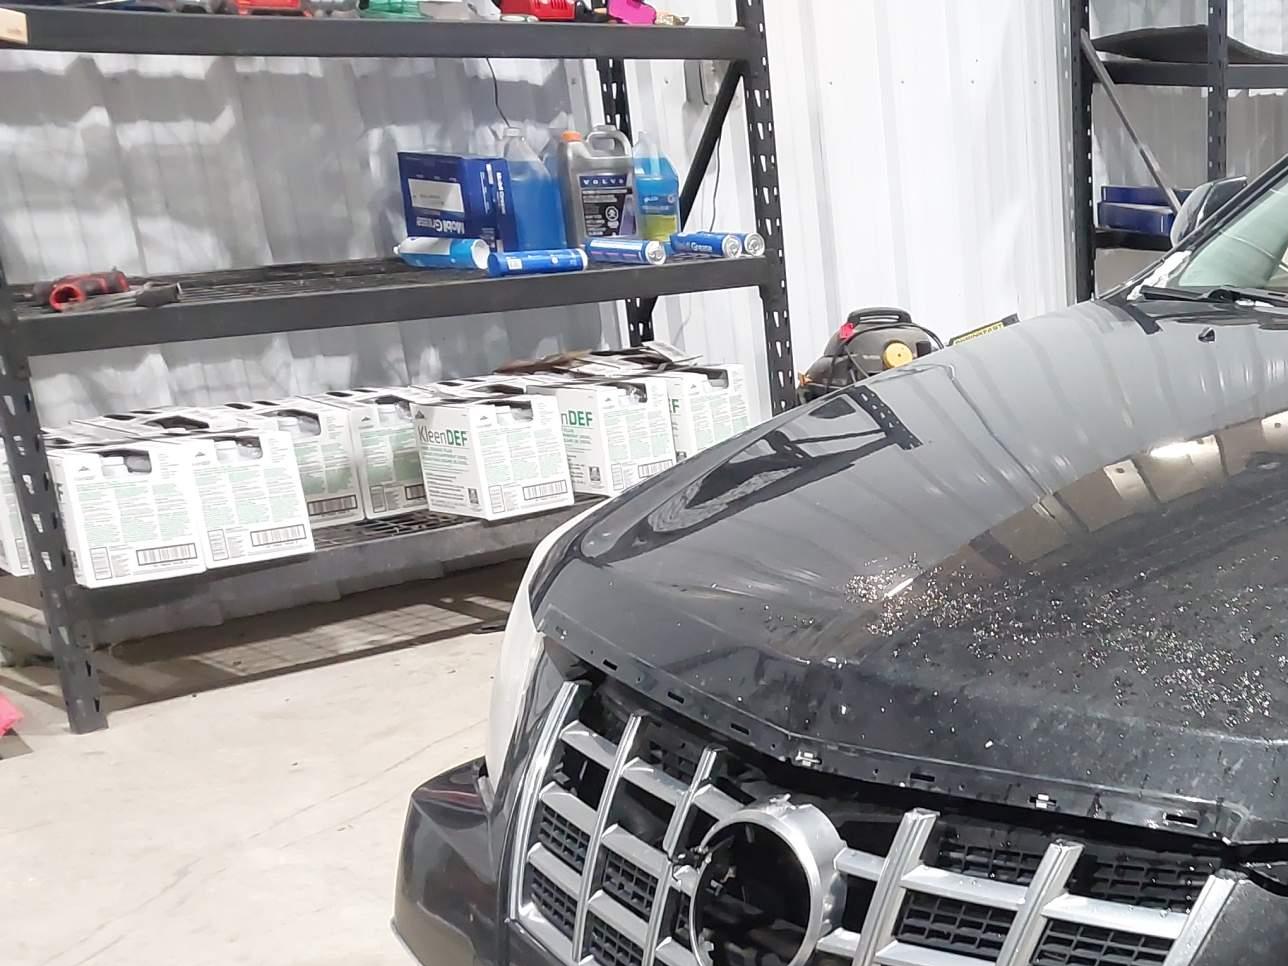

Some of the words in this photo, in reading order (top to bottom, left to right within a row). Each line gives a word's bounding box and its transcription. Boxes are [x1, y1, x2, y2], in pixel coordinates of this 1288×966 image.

[443, 220, 465, 234] Mobil
[560, 410, 593, 426] nDEF
[418, 425, 468, 446] KleenDEF
